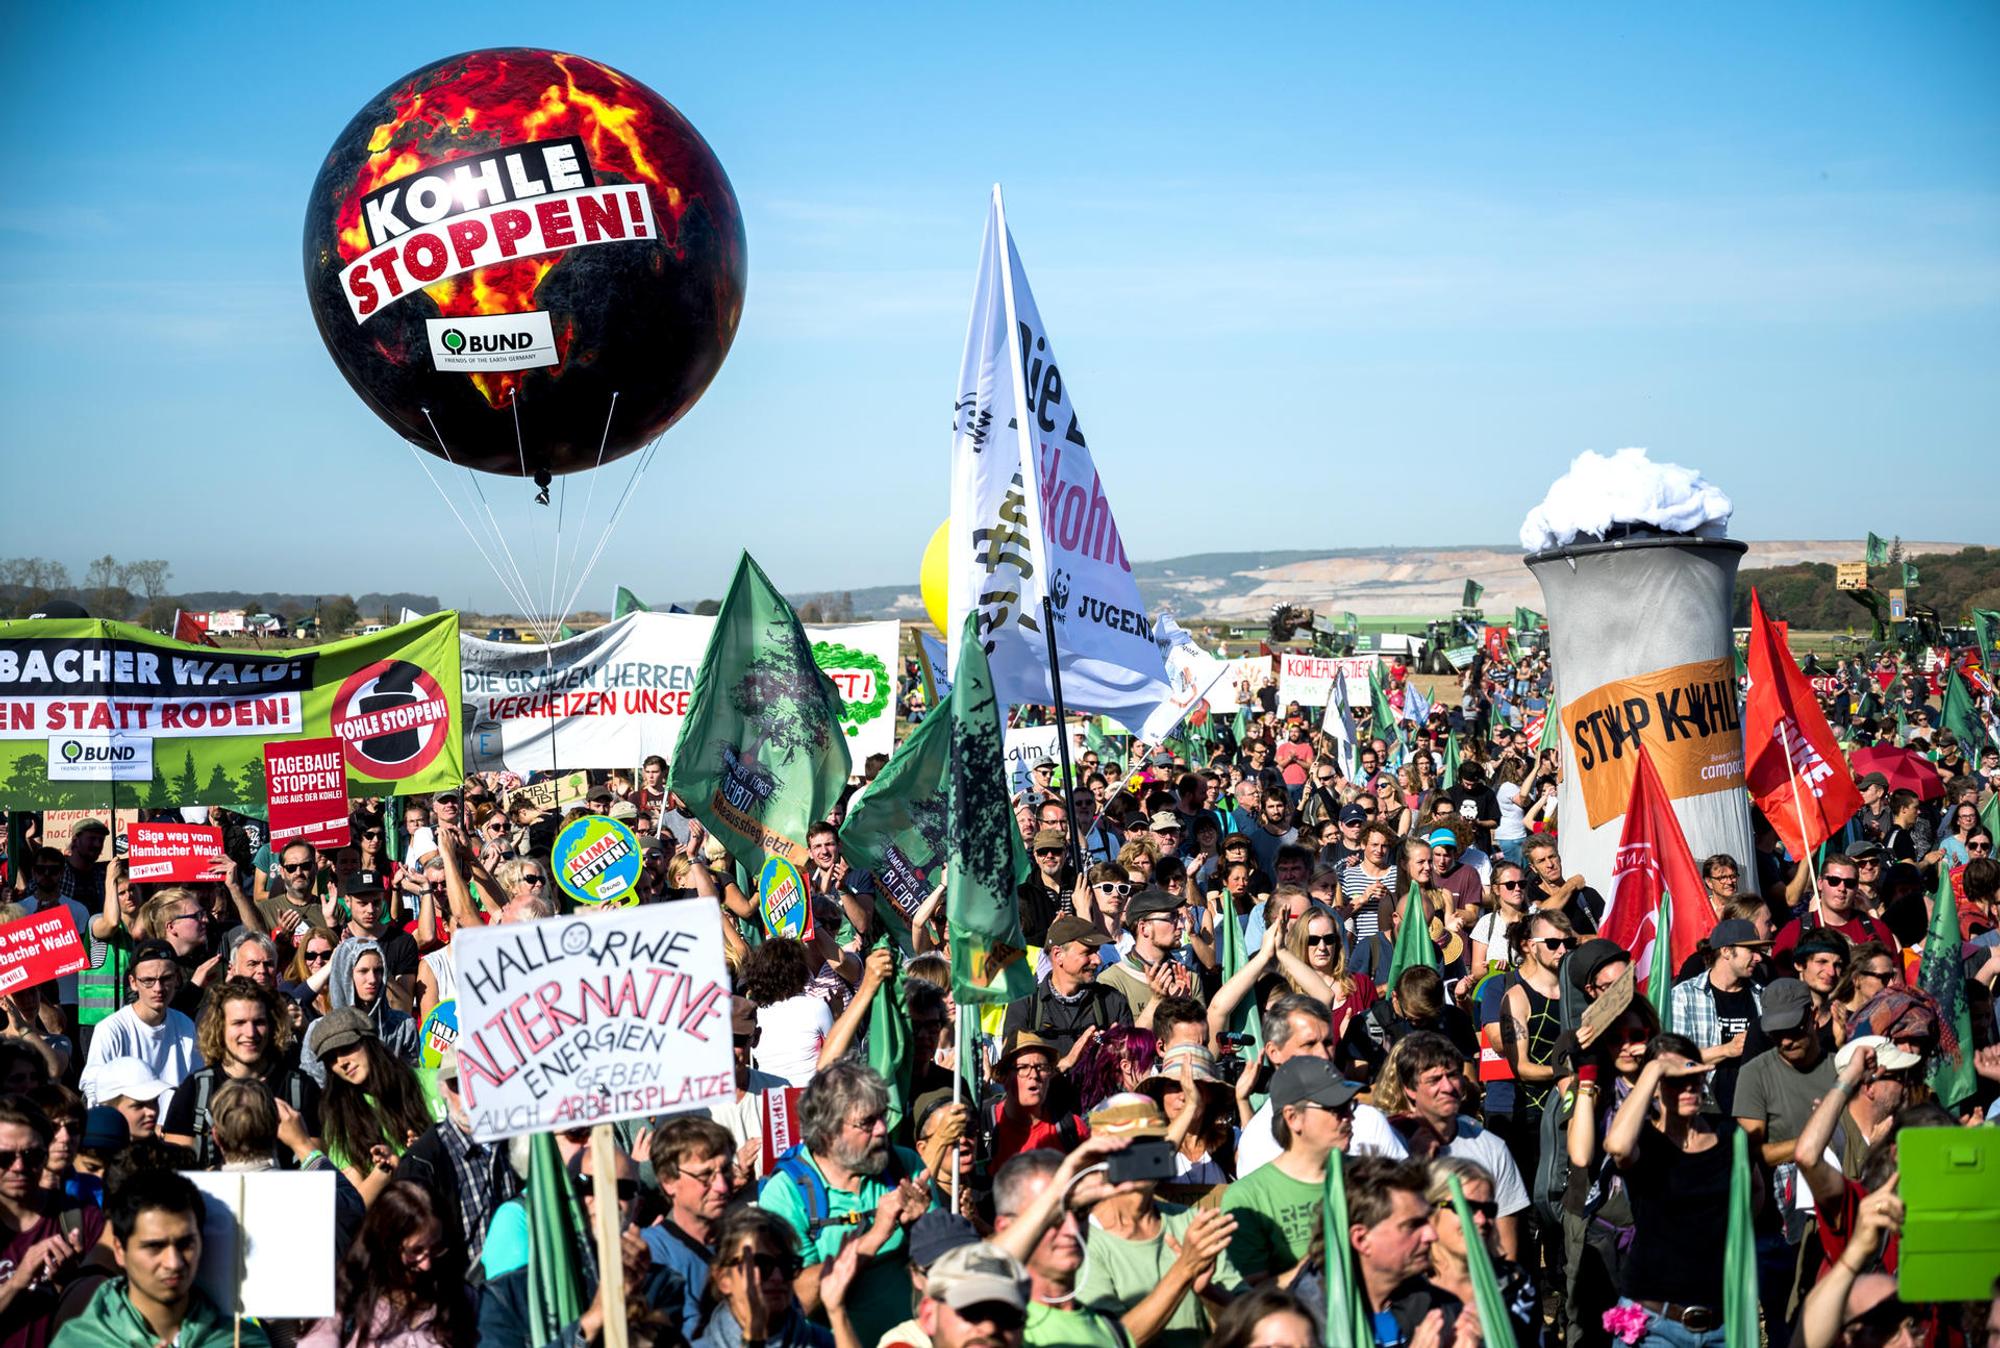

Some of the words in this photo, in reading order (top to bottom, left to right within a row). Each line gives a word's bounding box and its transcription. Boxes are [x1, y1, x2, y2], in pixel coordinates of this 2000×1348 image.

[366, 144, 585, 246] KOHLE
[349, 191, 648, 315] STOPPEN!
[469, 332, 533, 352] BUND
[463, 669, 500, 693] DIE
[505, 664, 597, 694] GRAUEN
[604, 662, 700, 691] HERREN
[46, 702, 153, 730] STATT
[162, 698, 290, 729] RODEN!
[334, 714, 380, 742] KOHLE
[381, 699, 448, 732] STOPPEN!
[489, 690, 617, 720] VERHEIZEN
[84, 746, 135, 761] BUND
[268, 752, 341, 775] TAGEBAUE
[270, 795, 289, 806] RAUS
[290, 794, 304, 803] AUS
[304, 792, 318, 802] DER
[319, 790, 343, 801] KOHLE!
[272, 771, 340, 794] STOPPEN!
[130, 844, 190, 857] Hambacher
[192, 844, 222, 858] Wald!
[137, 829, 164, 844] Säge
[166, 832, 189, 844] weg
[191, 832, 213, 843] vom
[569, 835, 617, 873] KLIMA
[572, 841, 630, 889] RETTEN!
[886, 848, 919, 892] HAMBACHER
[768, 879, 793, 909] KLIMA
[770, 888, 800, 926] RETTEN!
[8, 927, 35, 944] weg
[35, 918, 62, 935] vom
[41, 929, 78, 952] Wald!
[598, 930, 698, 968] RWE
[456, 967, 732, 1110] ALTERNATIVE
[523, 1020, 666, 1100] ENERGIEN
[575, 1062, 662, 1090] GEBEN
[475, 1104, 541, 1135] AUCH
